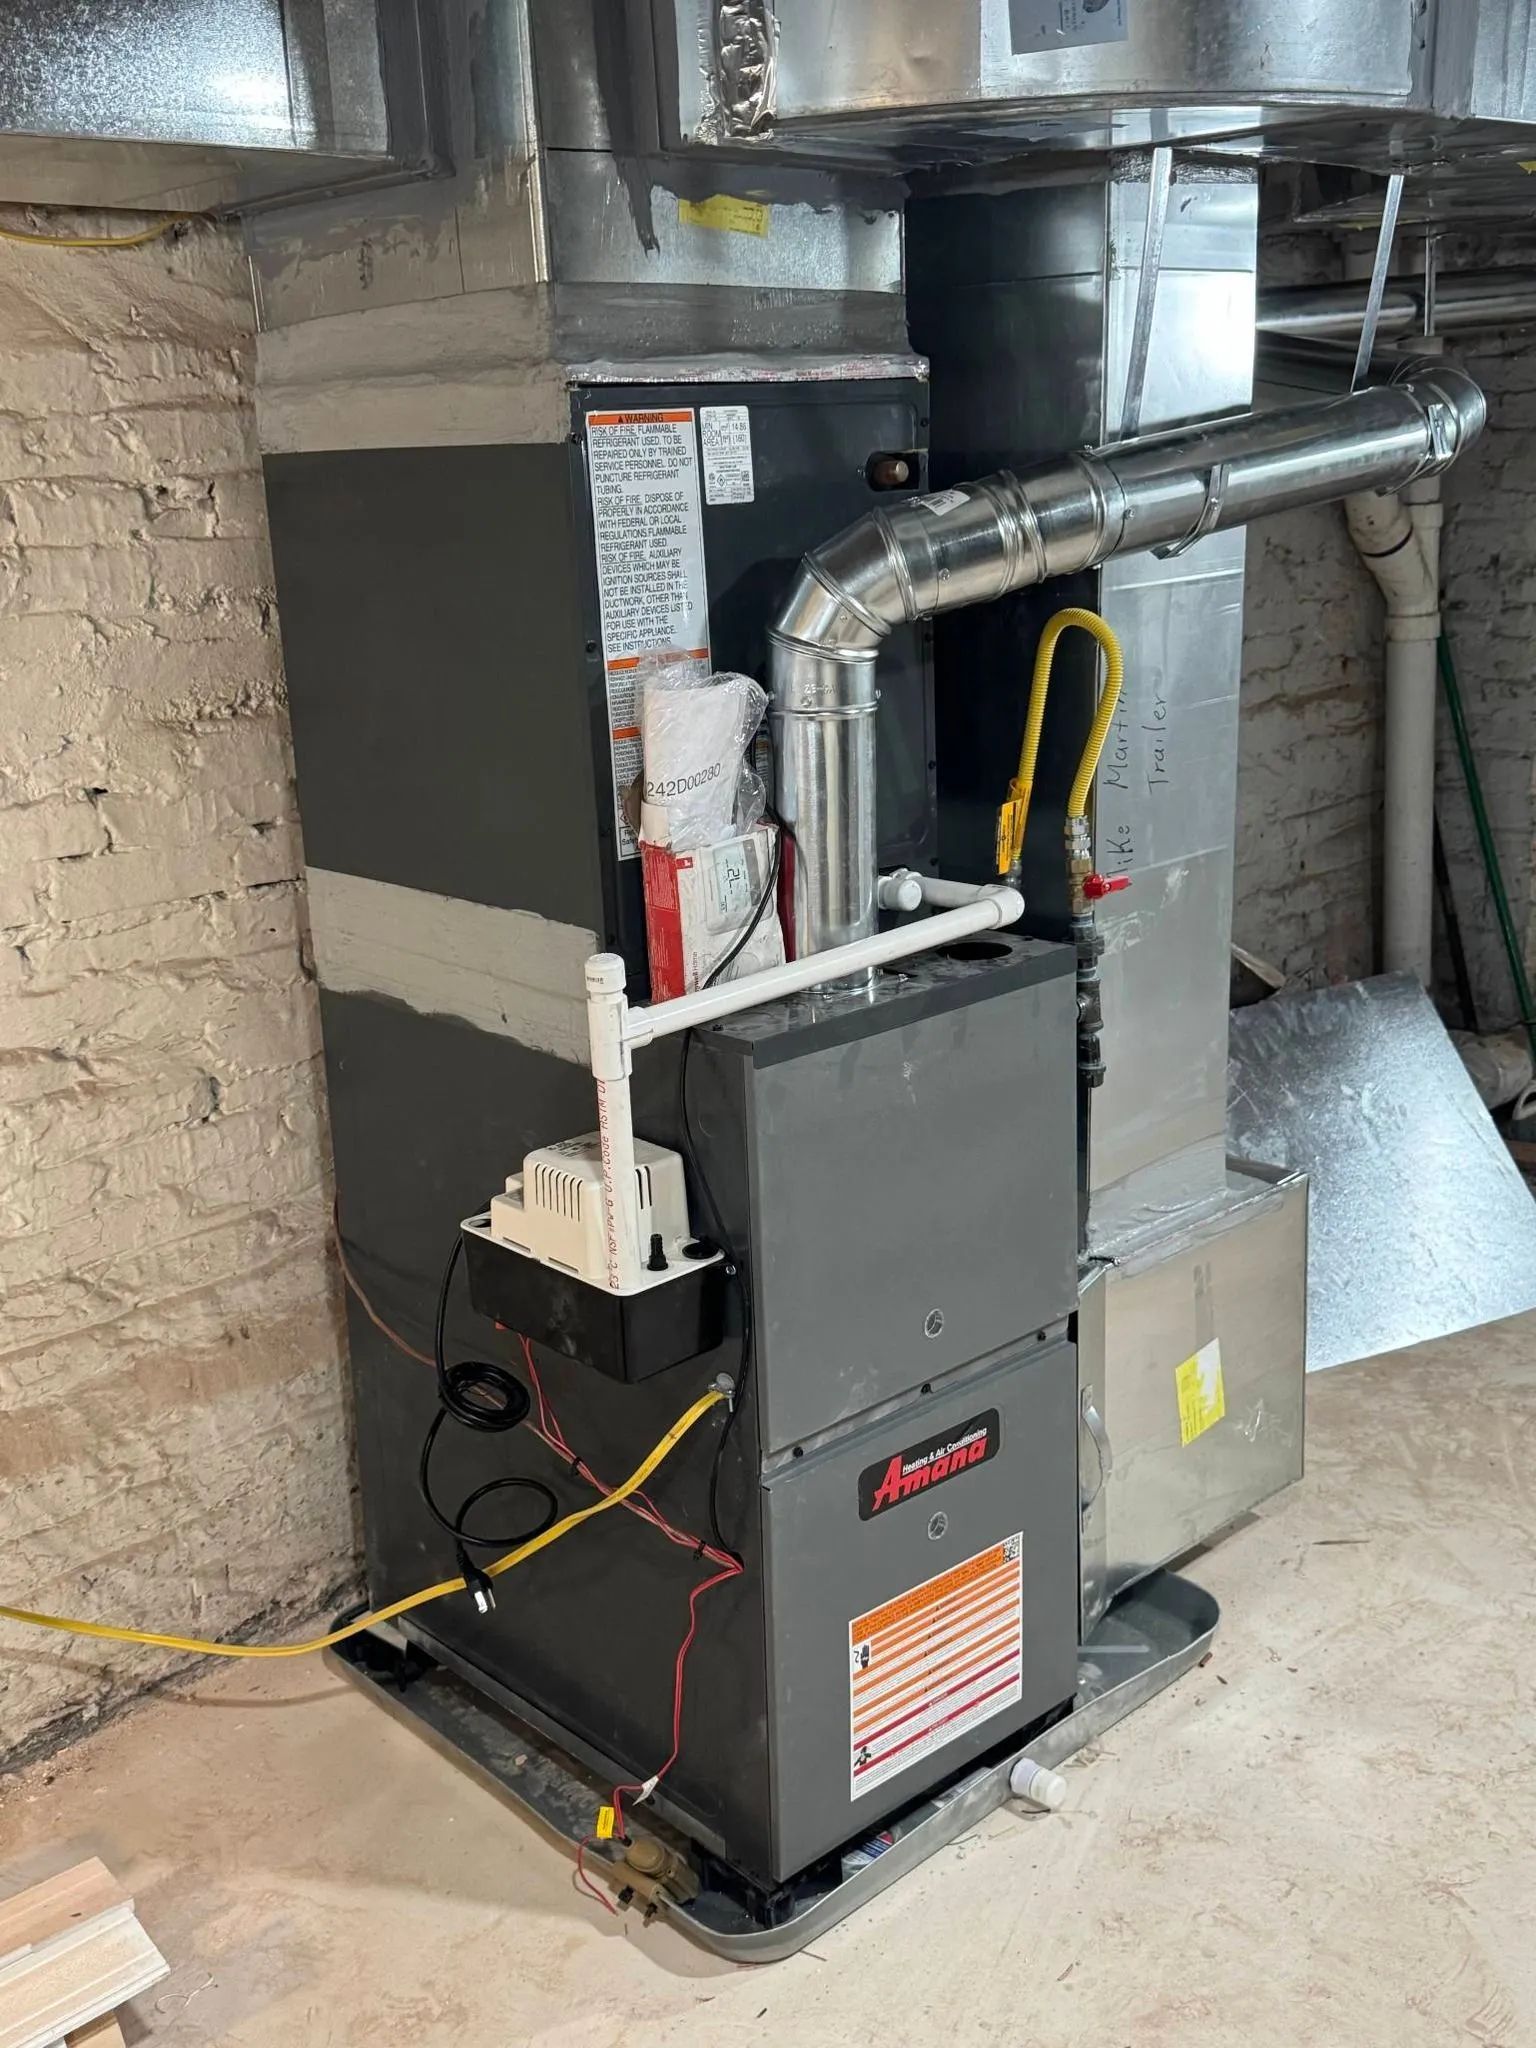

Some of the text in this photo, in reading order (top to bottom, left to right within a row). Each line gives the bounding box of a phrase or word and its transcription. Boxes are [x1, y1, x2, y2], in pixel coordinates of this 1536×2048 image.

[625, 412, 664, 423] WARNING
[592, 426, 607, 437] RISK
[609, 425, 619, 435] OF
[638, 423, 677, 434] FLAMMABLE
[592, 437, 639, 448] REFRIGERANT
[662, 436, 672, 445] TO
[674, 435, 682, 444] BE
[593, 446, 687, 460] REPAIRED ONLY BY TRAINED
[595, 460, 624, 472] SERVICE
[668, 458, 678, 468] DO
[679, 457, 692, 467] NOT
[595, 469, 680, 483] PUNCTURE REFRIGERANT
[597, 496, 613, 507] RISK
[615, 495, 624, 505] OF
[644, 491, 673, 503] DISPOSE
[674, 491, 684, 501] OF
[598, 502, 689, 518] PROPERLY IN ACCORDANCE
[599, 514, 681, 530] WITH FEDERAL OR LOCAL
[600, 540, 648, 552] REFRIGERANT
[601, 552, 617, 564] RISK
[618, 551, 628, 562] OF
[648, 547, 682, 560] AUXILIARY
[602, 559, 680, 575] DEVICES WHICH MAY BE
[602, 569, 688, 586] IGNITION SOURCES SHALL
[603, 580, 688, 598] NOT BE INSTALLED IN THE
[645, 594, 670, 605] OTHER
[605, 601, 693, 620] AUXILIARY DEVICES LISTD
[606, 614, 669, 631] FOR USE WITH THE
[606, 629, 638, 642] SPECIFIC
[607, 642, 621, 654] SEE
[1141, 694, 1169, 794] Trailer
[902, 1427, 988, 1476] Heating & Air Conditioning
[872, 1437, 988, 1511] Amana
